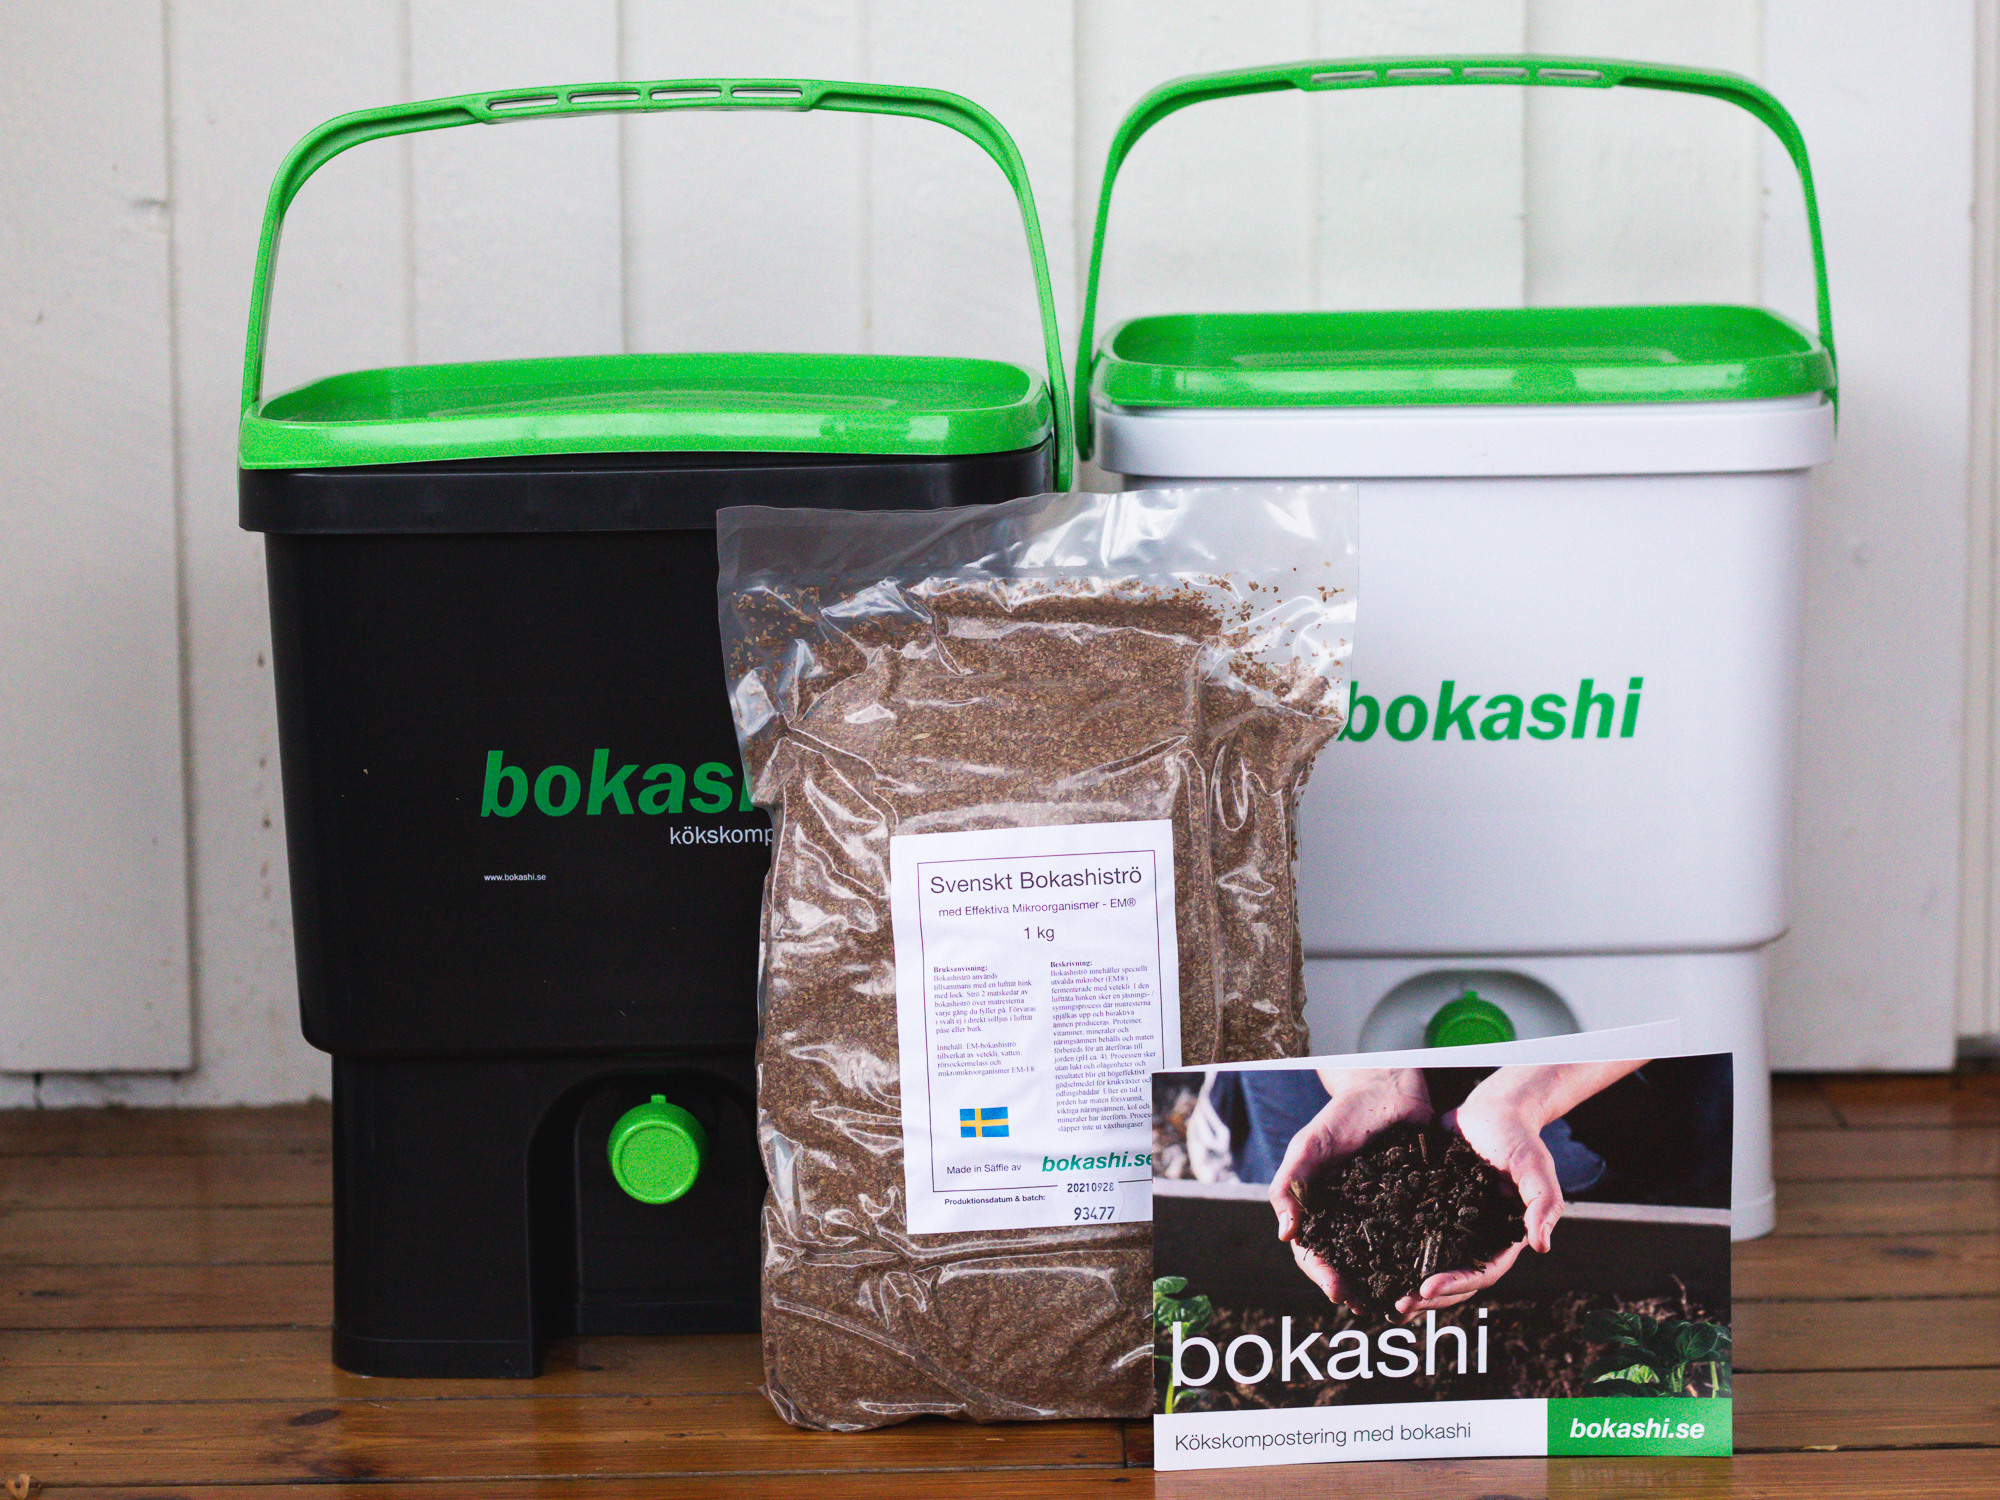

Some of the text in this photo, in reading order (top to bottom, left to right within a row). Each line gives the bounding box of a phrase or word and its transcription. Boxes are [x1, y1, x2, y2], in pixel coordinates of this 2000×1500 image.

[1337, 677, 1644, 742] bokashi
[484, 873, 546, 881] www.bokashi.se
[931, 866, 1142, 894] Svenskt Bokashiströ
[939, 907, 961, 917] med
[965, 904, 1009, 915] Effektiva
[1012, 900, 1099, 913] Mikroorganismer
[1110, 898, 1136, 908] EM®
[1024, 926, 1055, 941] 1 kg
[1121, 966, 1148, 974] speciellt
[1052, 1004, 1101, 1012] syrningsprocess
[1052, 1012, 1077, 1020] spjälkas
[1054, 1056, 1074, 1064] jorden
[1107, 1069, 1145, 1077] högeffektivt
[1055, 1080, 1095, 1089] gödselmedel
[1056, 1099, 1076, 1107] jorden
[947, 1166, 971, 1174] Made
[984, 1164, 1009, 1172] Säffle
[1066, 1182, 1114, 1193] 20210928
[944, 1197, 1012, 1205] Produktionsdatum
[1172, 1307, 1488, 1388] bokashi
[1570, 1418, 1705, 1439] bokashi.se
[1174, 1422, 1472, 1452] Kökskompostering med bokashi
